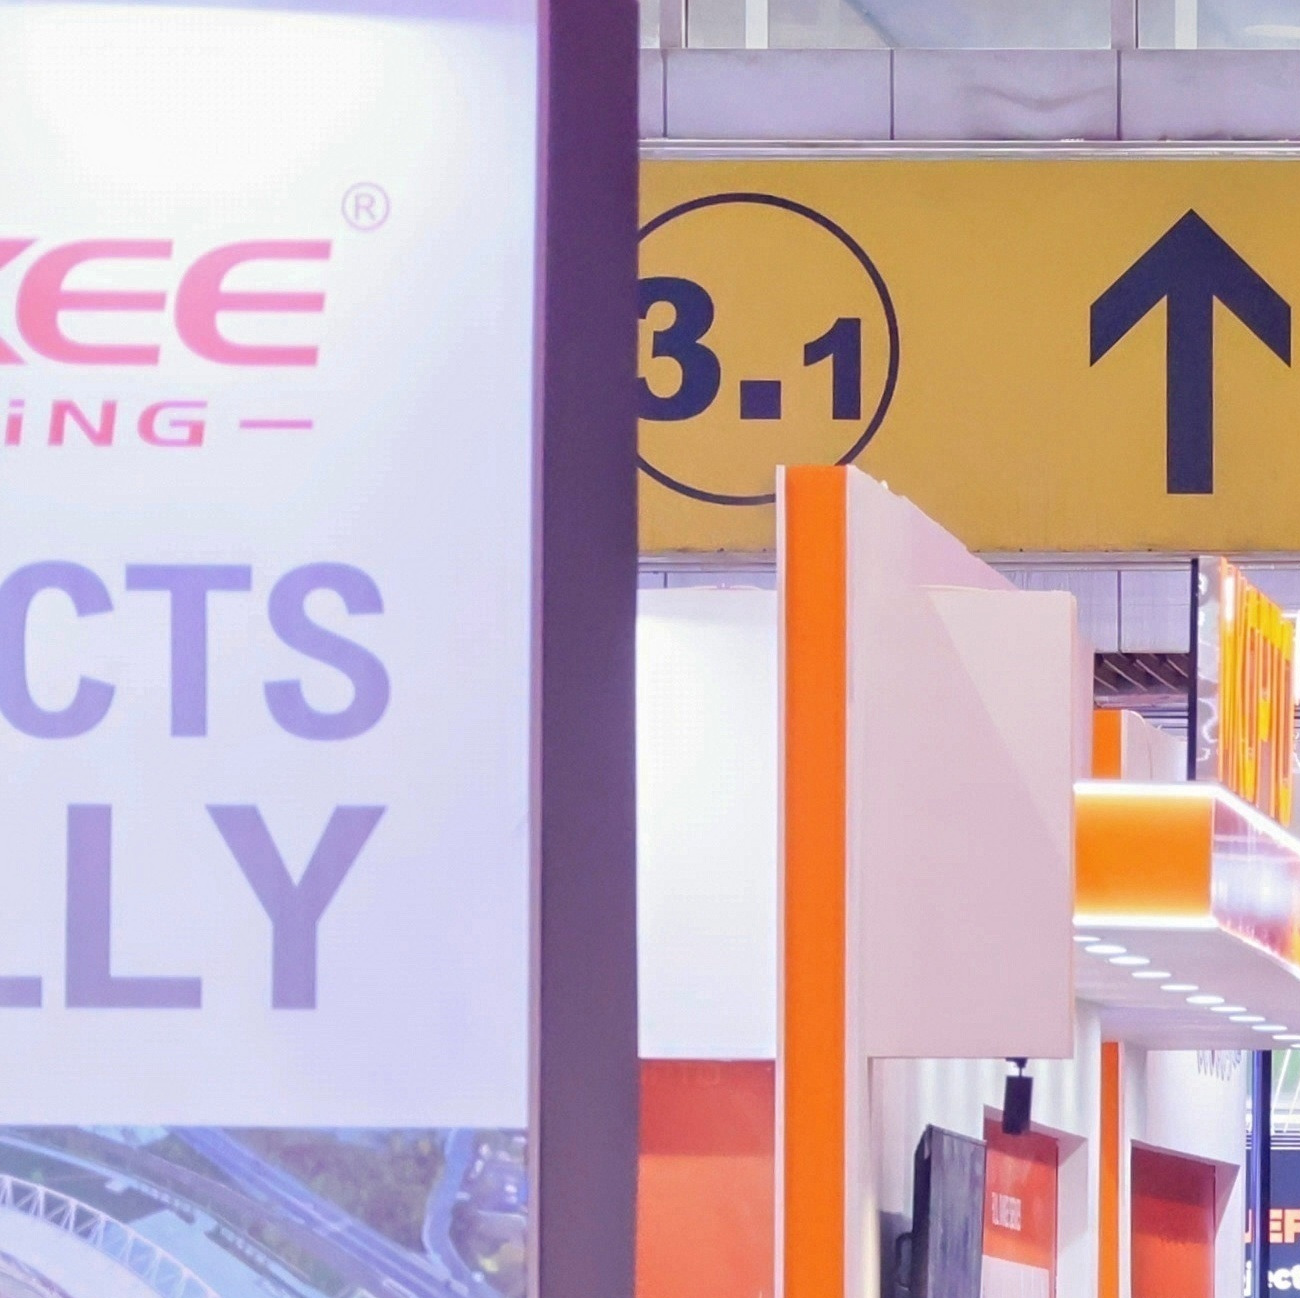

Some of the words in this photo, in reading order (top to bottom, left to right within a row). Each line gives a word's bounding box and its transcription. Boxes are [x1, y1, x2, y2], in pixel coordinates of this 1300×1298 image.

[0, 238, 333, 368] EE
[637, 277, 863, 421] 3.1
[0, 560, 392, 741] CTS
